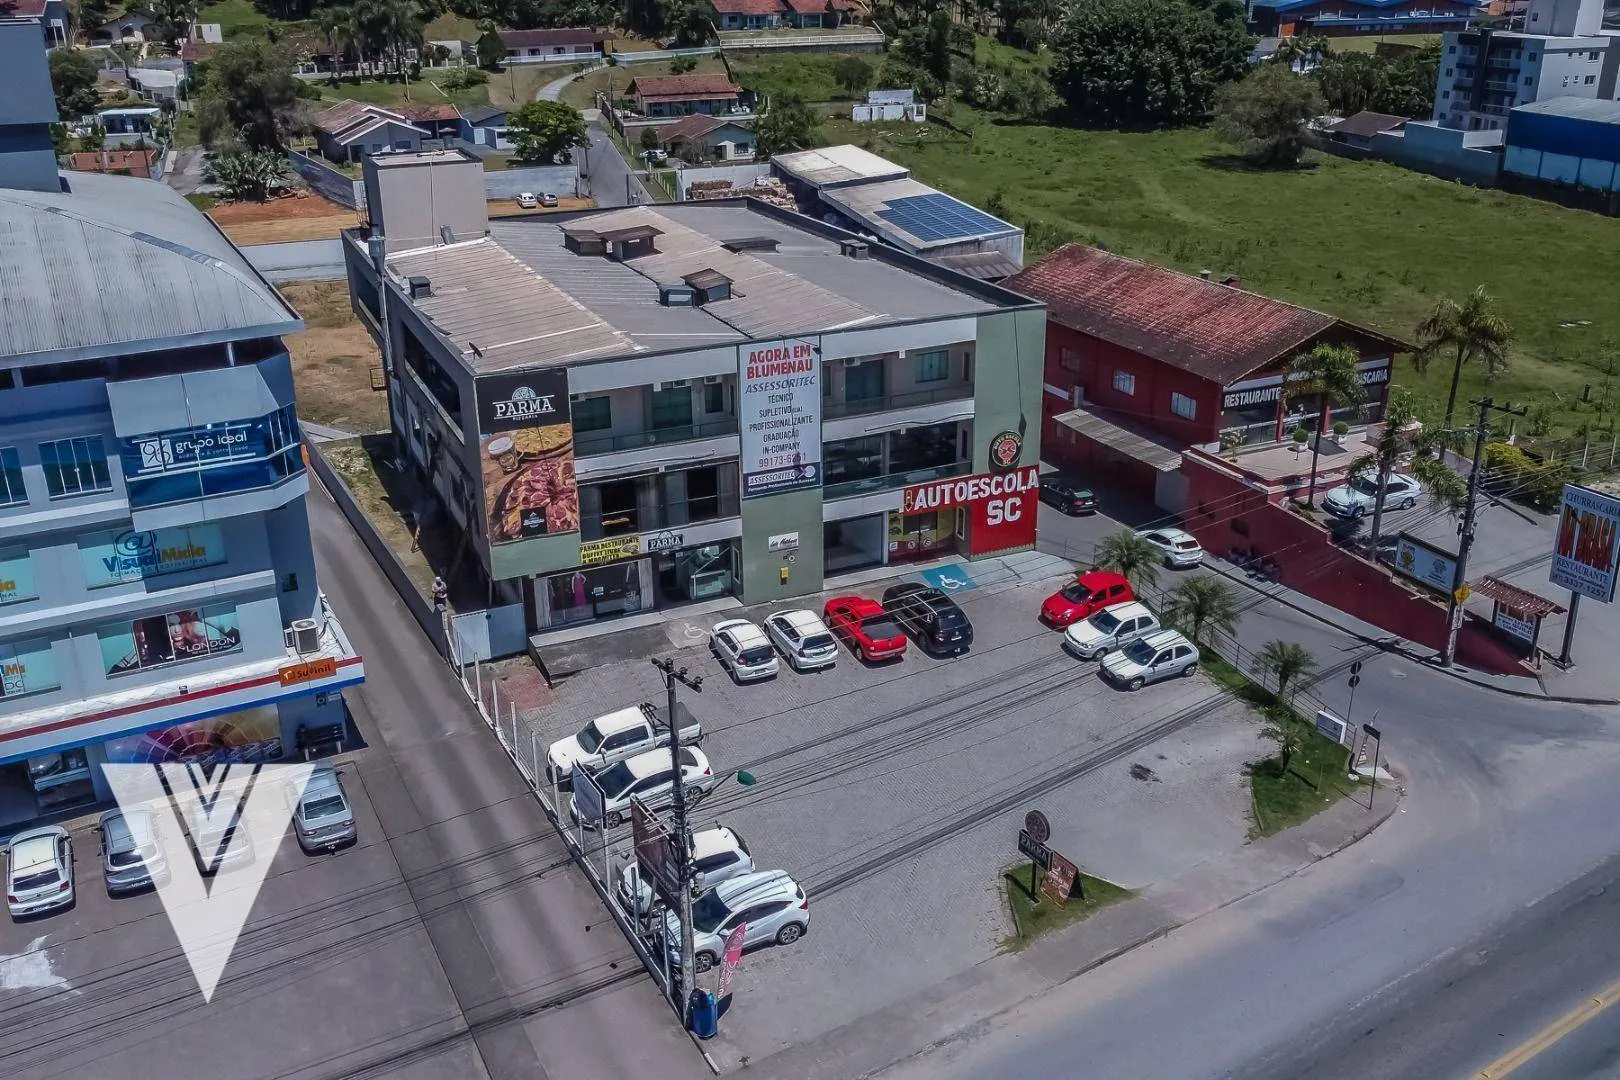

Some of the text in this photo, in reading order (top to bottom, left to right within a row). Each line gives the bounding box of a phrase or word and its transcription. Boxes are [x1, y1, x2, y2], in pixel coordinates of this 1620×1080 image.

[748, 345, 811, 364] AGORA EM
[746, 359, 813, 379] BLUMENAU
[745, 375, 816, 394] ASSESSORITEC
[768, 391, 794, 404] TÉCNICO
[1224, 386, 1282, 408] RESTAURANTE
[495, 398, 554, 417] PARMA
[759, 406, 792, 418] SUPLETIVO
[749, 415, 813, 432] PROFISSIONALIZANTE
[763, 430, 800, 443] GRADUAÇÃO
[763, 442, 800, 455] IN-COMPANY
[914, 468, 1040, 511] AUTOESCOLA
[986, 496, 1022, 526] SC
[1556, 557, 1609, 584] RESTAURANTE
[186, 636, 235, 653] LONDON
